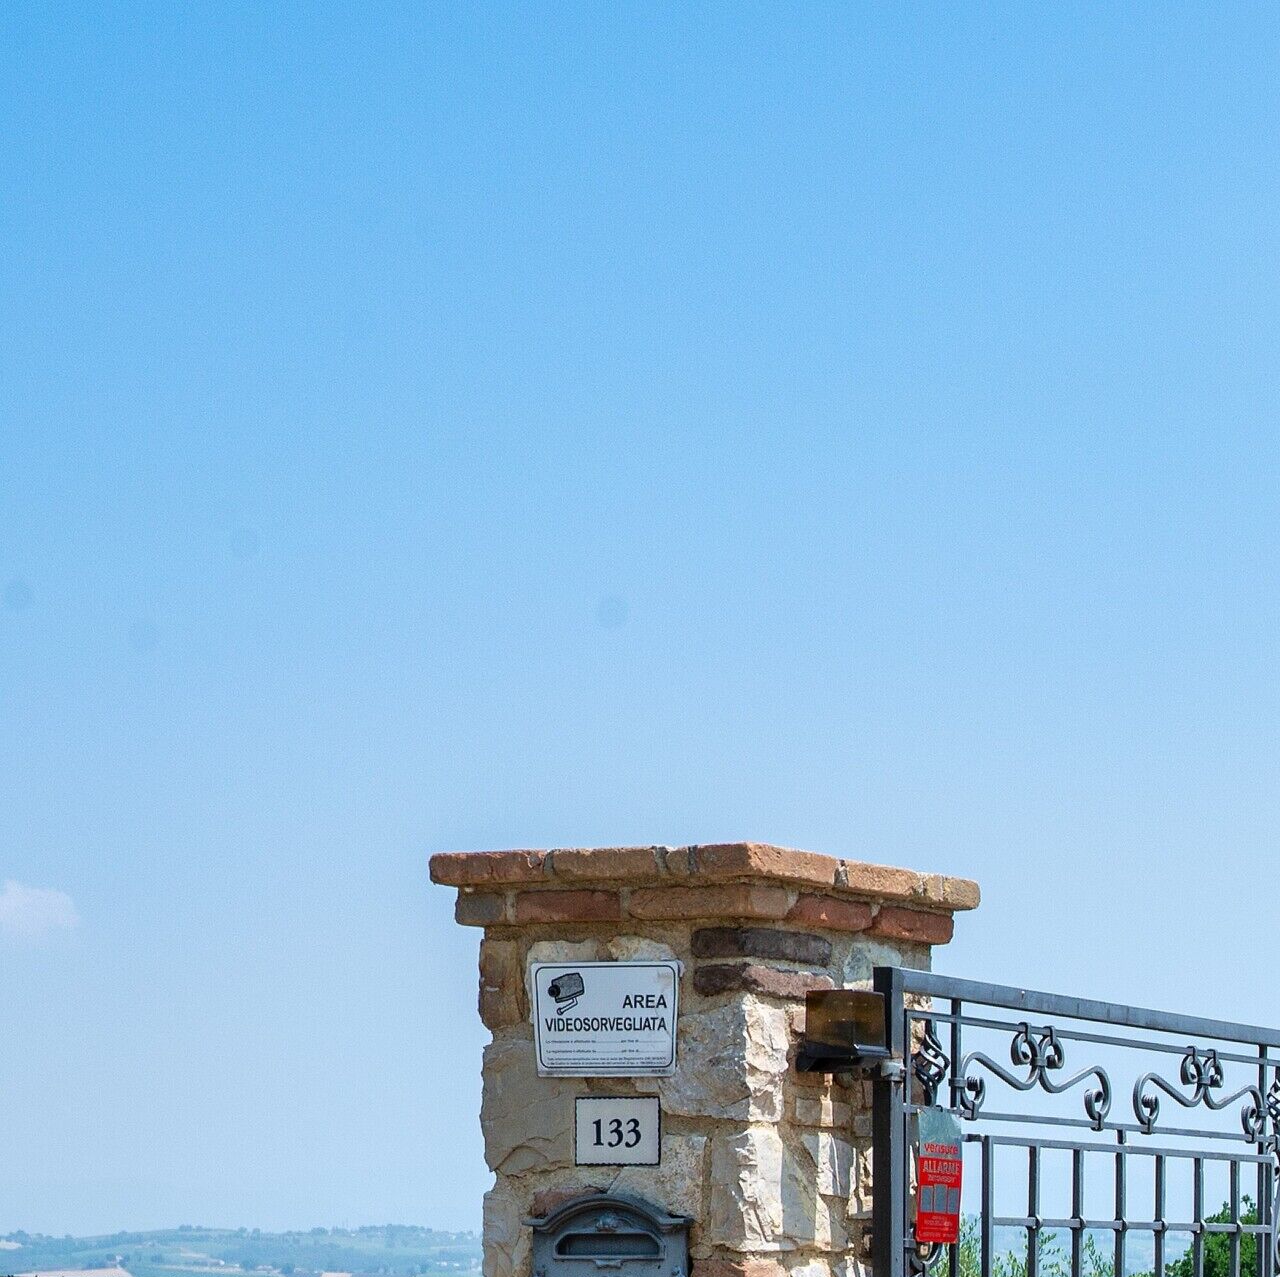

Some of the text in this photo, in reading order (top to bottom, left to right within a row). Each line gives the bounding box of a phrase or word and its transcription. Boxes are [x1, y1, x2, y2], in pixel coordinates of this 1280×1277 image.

[622, 994, 667, 1009] AREA
[545, 1017, 667, 1032] VIDEOSORVEGLIATA
[592, 1118, 642, 1148] 133
